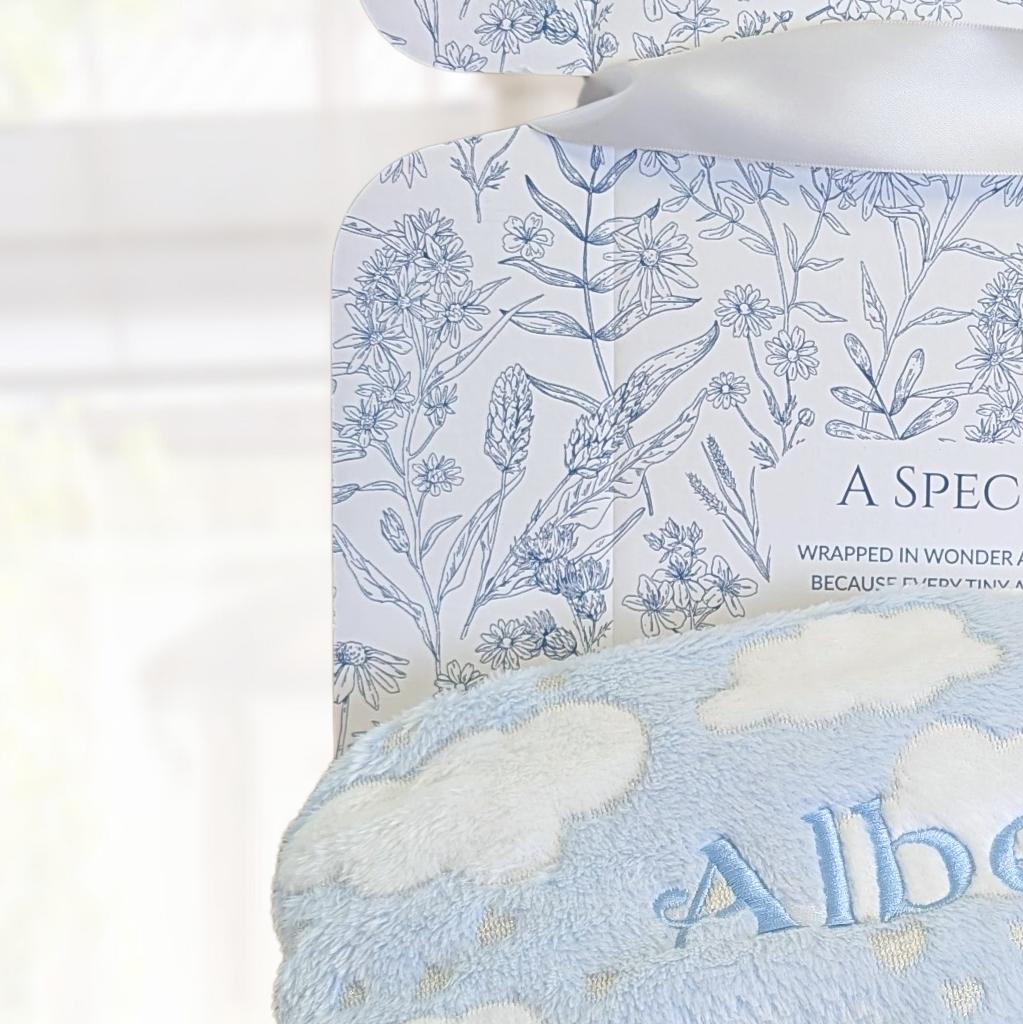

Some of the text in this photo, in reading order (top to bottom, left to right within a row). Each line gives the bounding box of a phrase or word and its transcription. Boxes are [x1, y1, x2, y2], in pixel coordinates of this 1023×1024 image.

[836, 464, 877, 507] A
[797, 544, 894, 563] WRAPPED
[899, 547, 919, 563] IN
[923, 548, 1013, 566] WONDER
